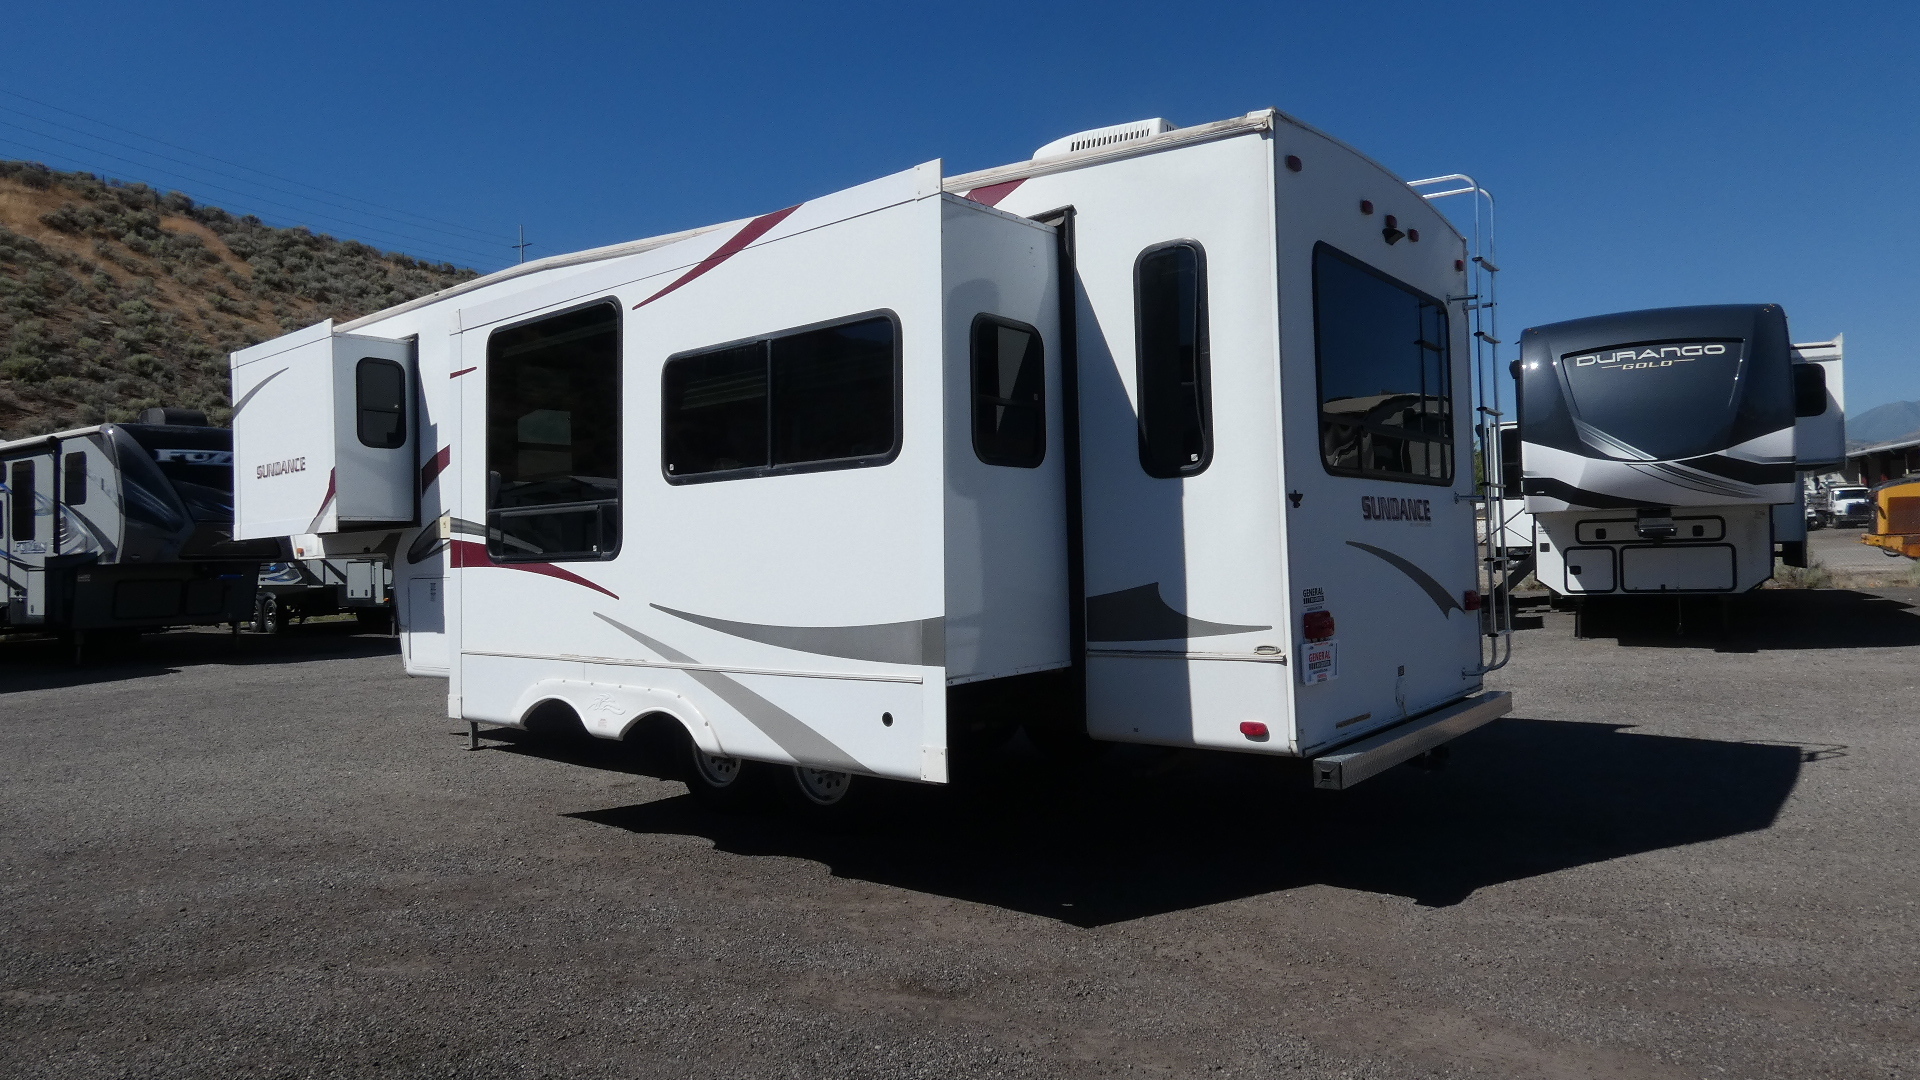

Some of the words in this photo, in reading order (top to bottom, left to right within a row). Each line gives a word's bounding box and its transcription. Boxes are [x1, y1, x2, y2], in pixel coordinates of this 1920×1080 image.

[1576, 344, 1726, 367] DURANGO
[1622, 360, 1673, 370] GOLD
[256, 456, 306, 480] SUNDANCE
[1361, 495, 1432, 522] SUNDANCE
[1302, 587, 1324, 598] GENERAL
[1308, 650, 1331, 663] GENERAL
